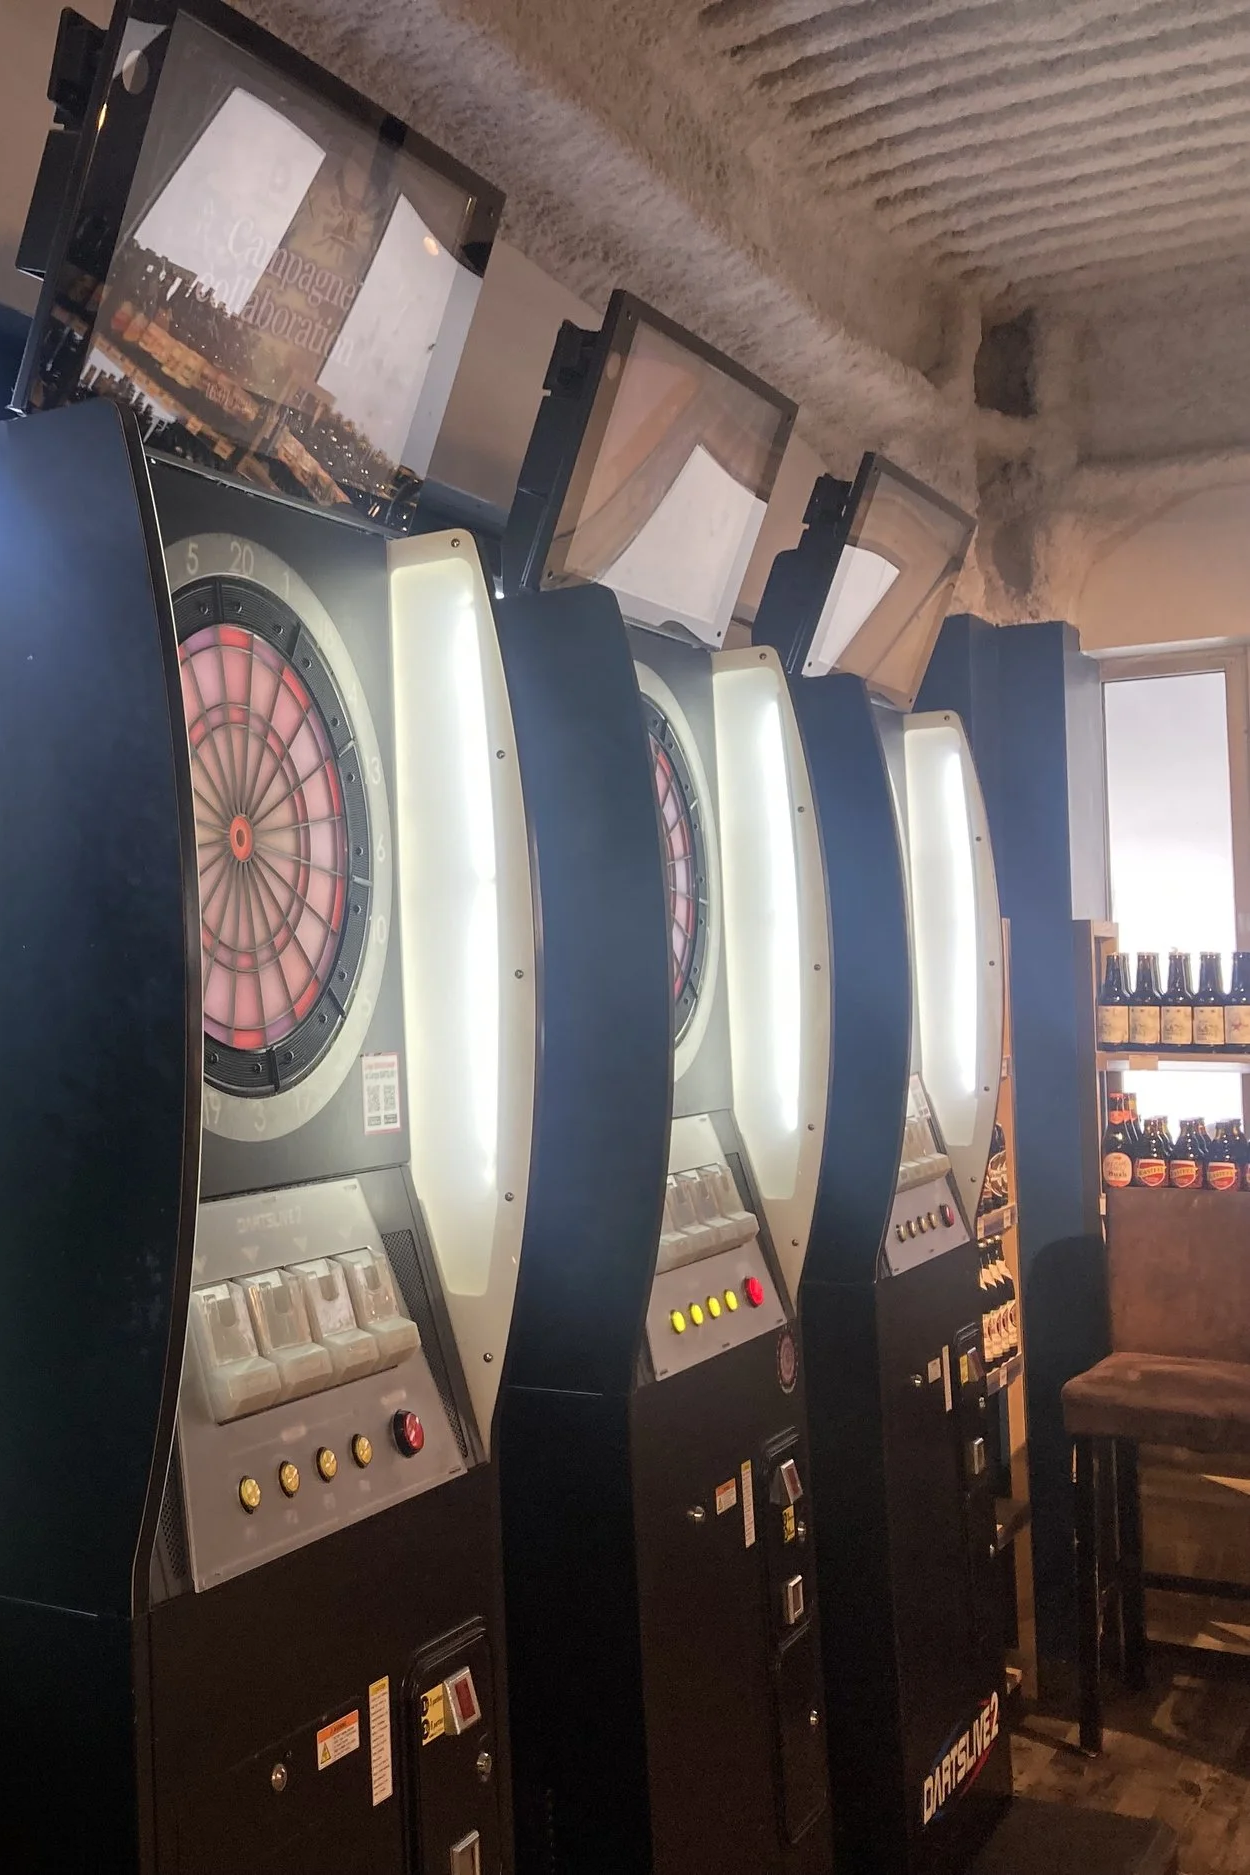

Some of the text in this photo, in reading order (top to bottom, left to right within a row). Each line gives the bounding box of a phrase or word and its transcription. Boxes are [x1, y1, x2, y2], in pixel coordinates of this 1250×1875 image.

[187, 543, 199, 575] 5
[230, 541, 254, 576] 20
[923, 1691, 999, 1825] DARTSLIVE2
